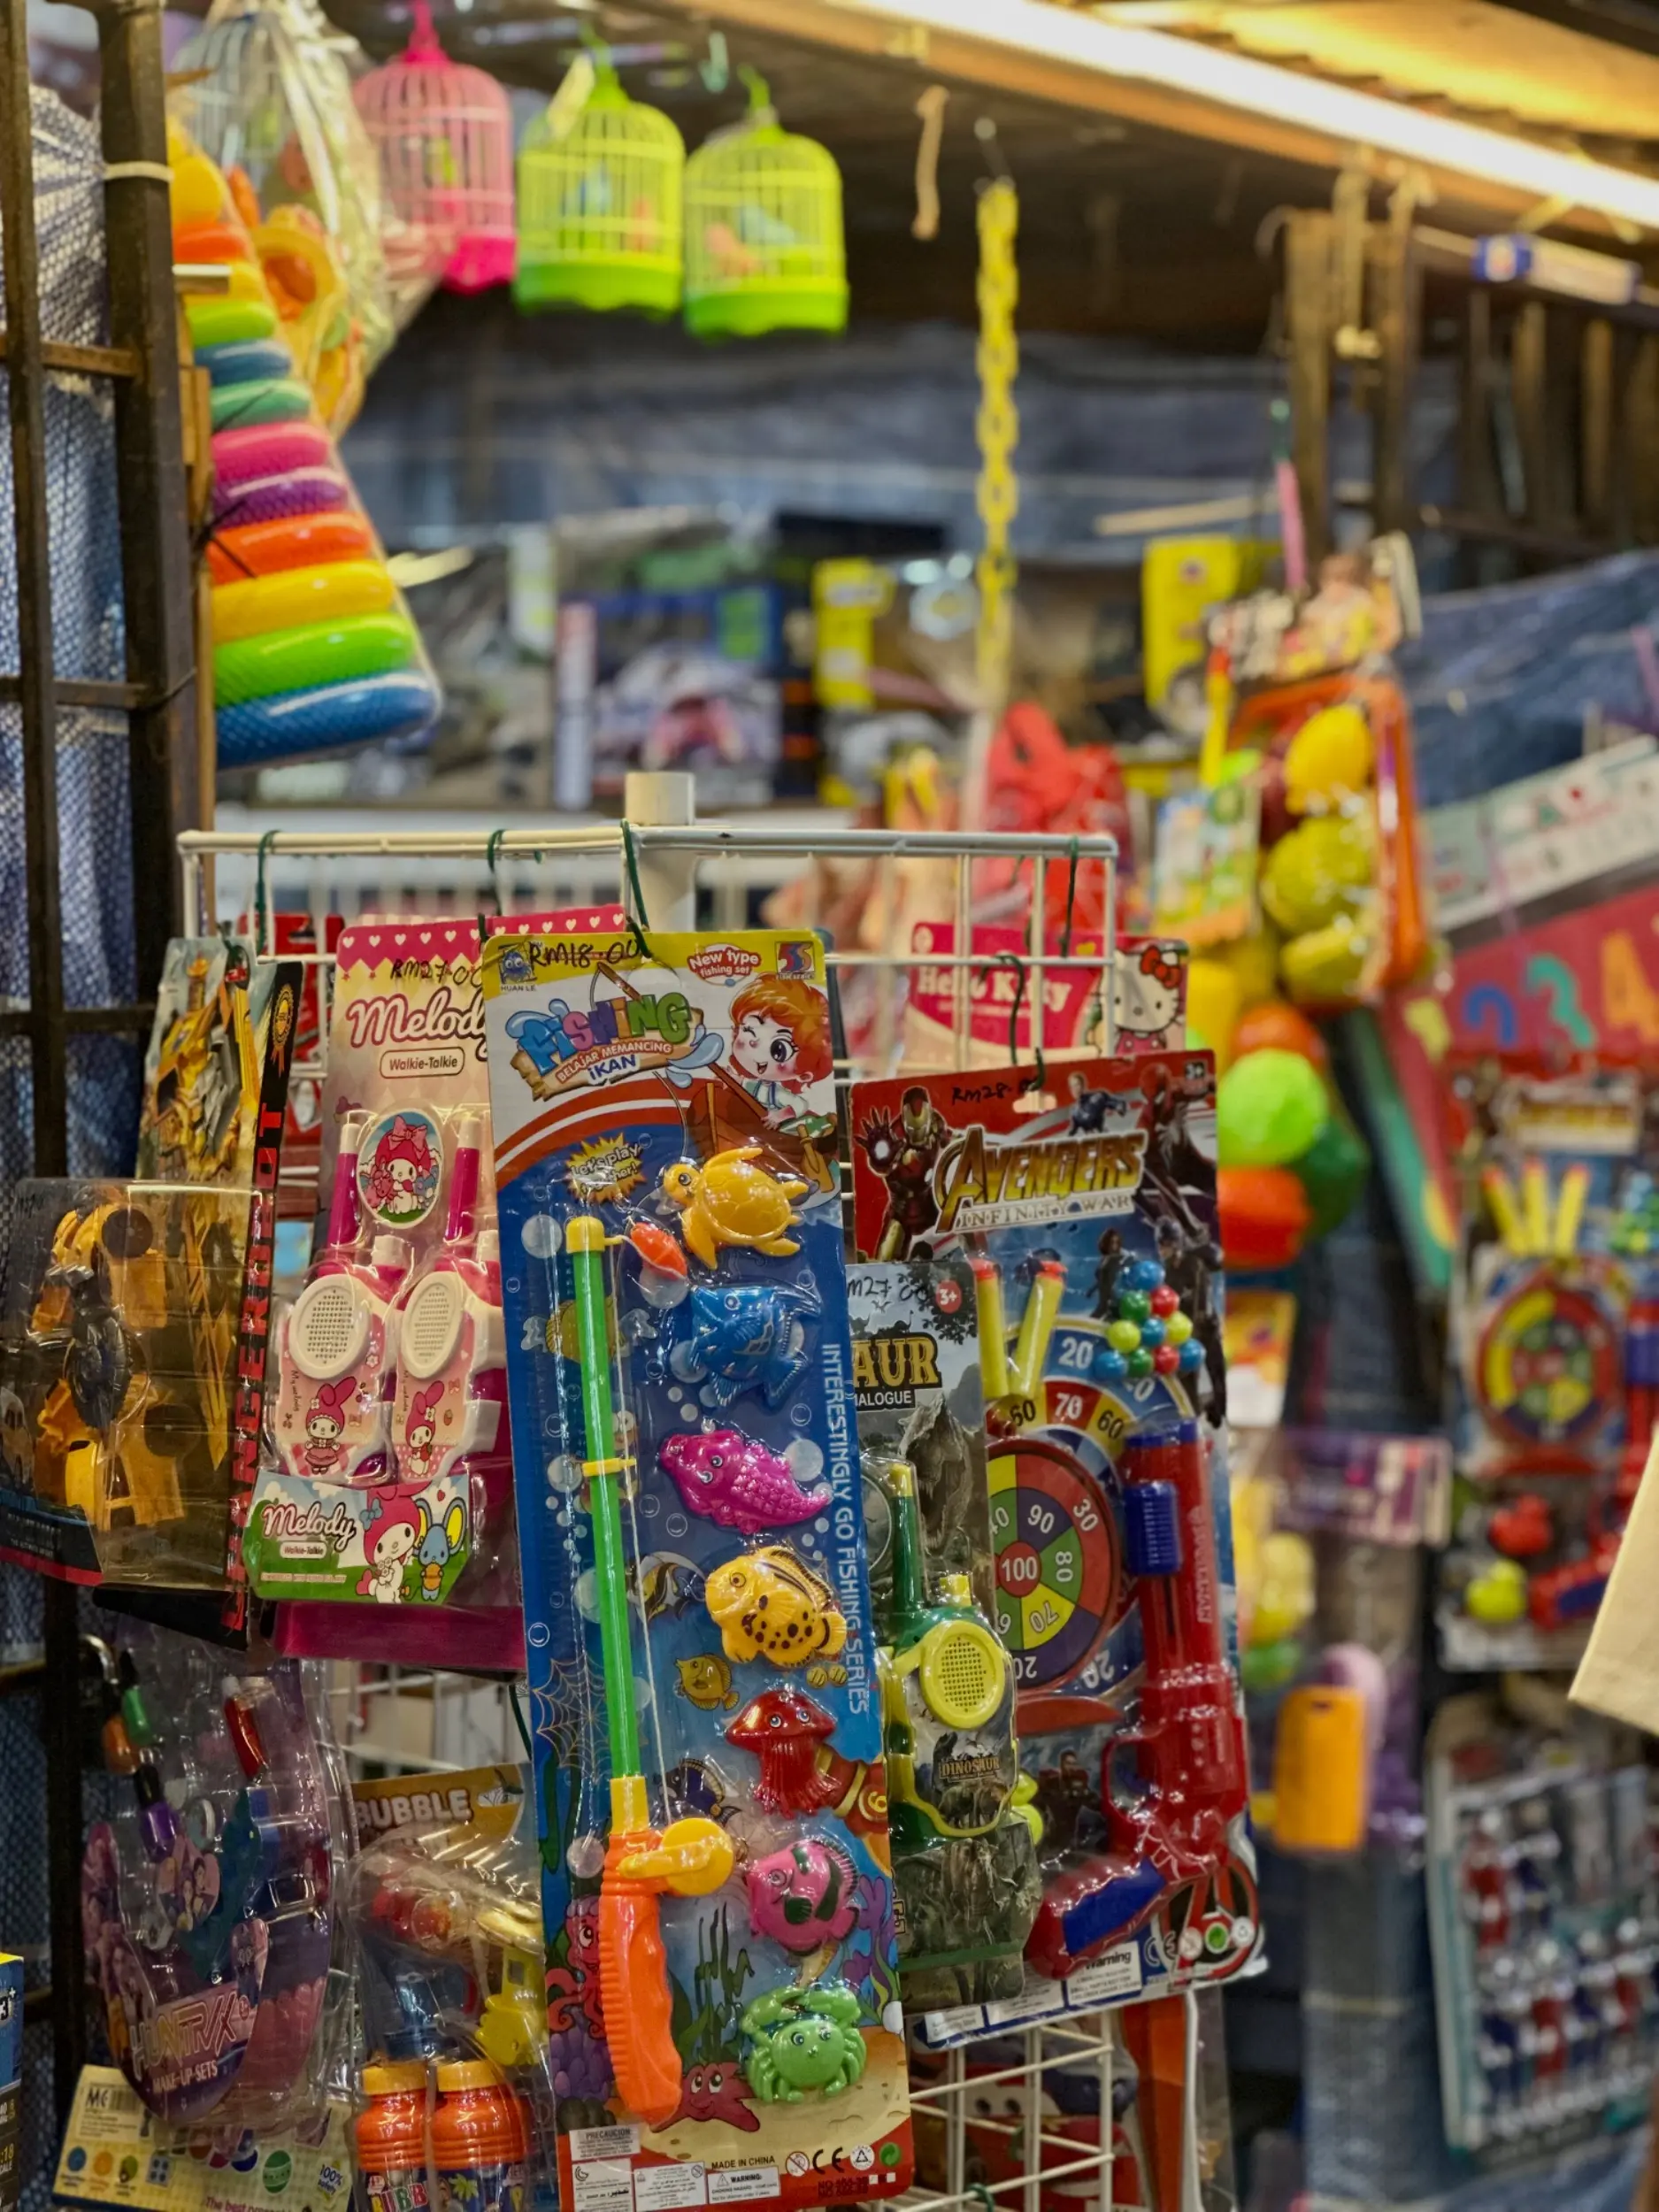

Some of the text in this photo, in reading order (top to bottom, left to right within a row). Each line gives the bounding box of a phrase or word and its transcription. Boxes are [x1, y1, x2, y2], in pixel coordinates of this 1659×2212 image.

[689, 949, 759, 970] New type
[700, 964, 750, 978] fishing set
[389, 1056, 457, 1071] Walkie-Talkie
[936, 1128, 1146, 1233] AVENGERS
[1081, 1197, 1131, 1211] WAR
[939, 1288, 957, 1305] 3+
[1059, 1337, 1094, 1370] 20
[1055, 1393, 1083, 1420] 70
[1096, 1409, 1125, 1440] 60
[263, 1501, 357, 1553] Melody
[821, 1343, 869, 1715] INTERESTINGLY GO FISHING SERIES
[1027, 1504, 1056, 1534] 90
[1072, 1499, 1100, 1532] 30
[1001, 1555, 1039, 1582] 100
[1055, 1550, 1073, 1583] 80
[1028, 1601, 1060, 1633] 70
[354, 1788, 472, 1830] BUBBLE
[711, 2160, 735, 2170] MADE
[749, 2155, 776, 2166] CHINA
